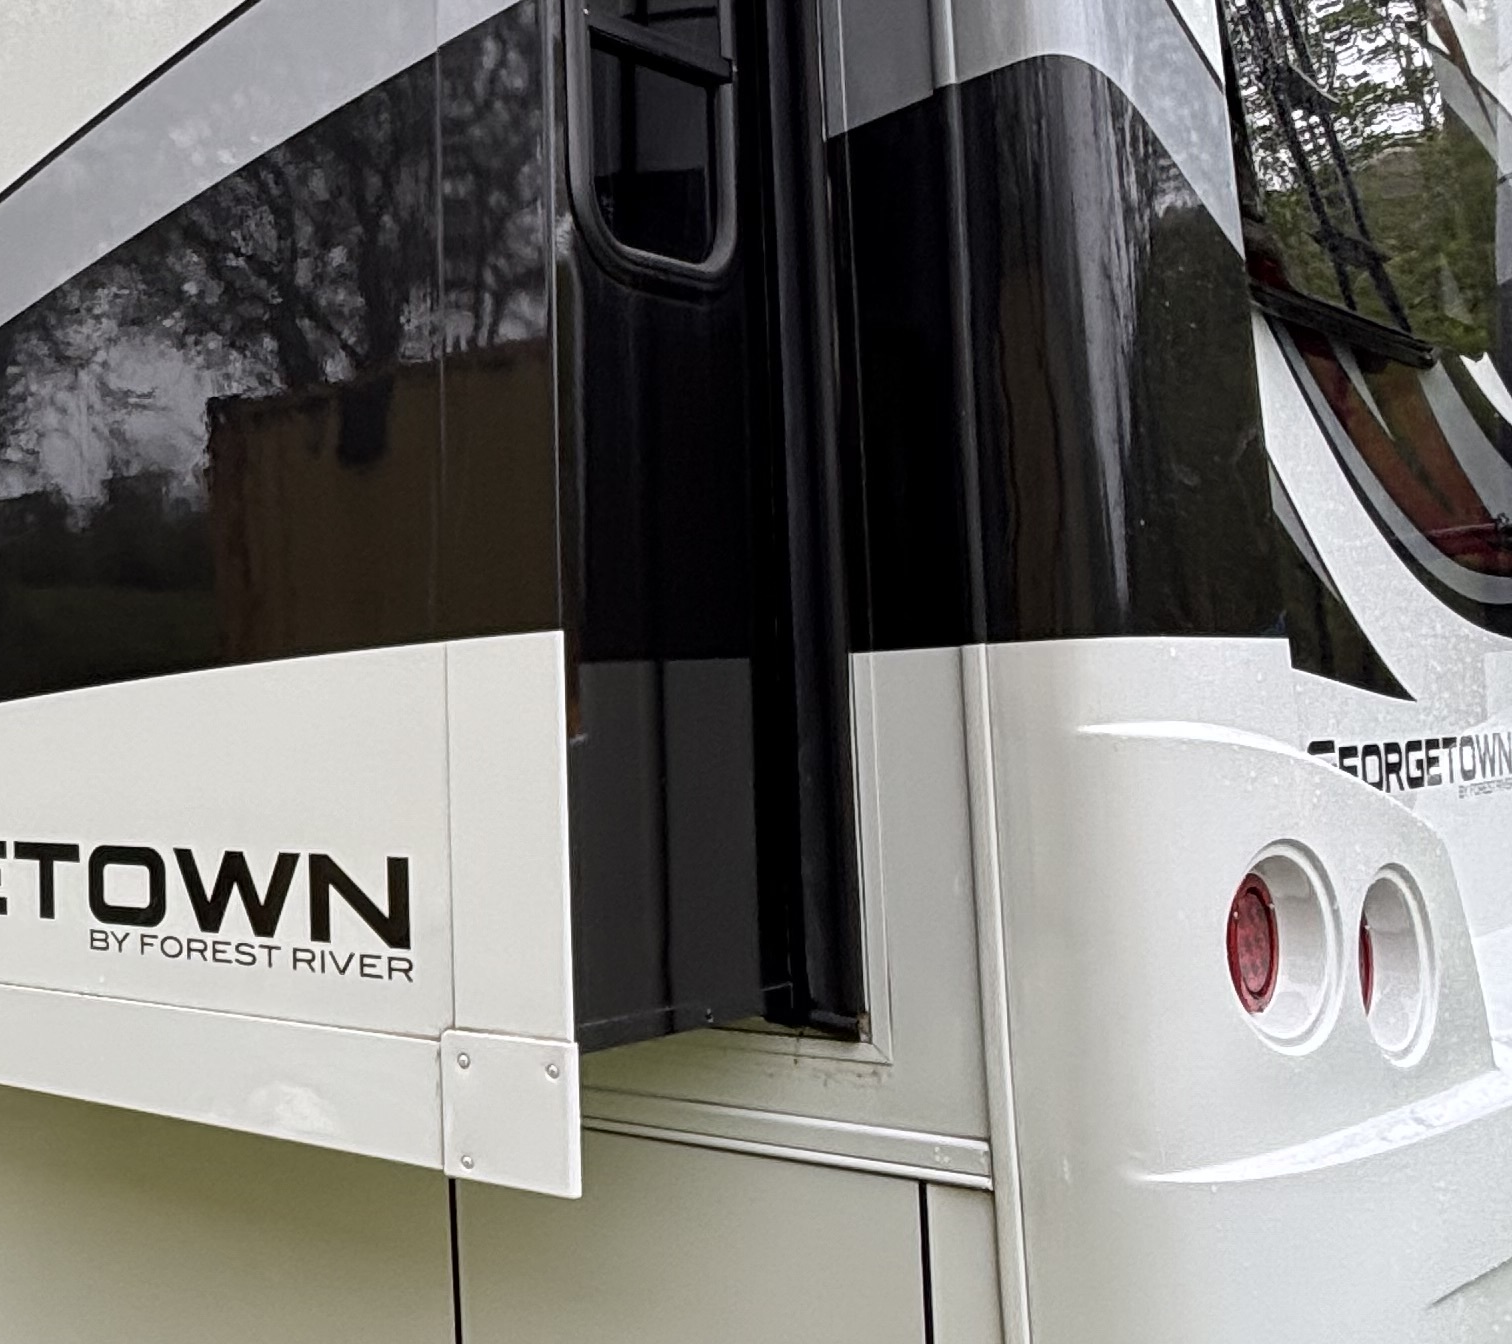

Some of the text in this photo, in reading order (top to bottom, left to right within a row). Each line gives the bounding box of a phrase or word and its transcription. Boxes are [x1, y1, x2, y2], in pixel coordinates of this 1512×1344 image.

[89, 928, 414, 983] BY FOREST RIVER
